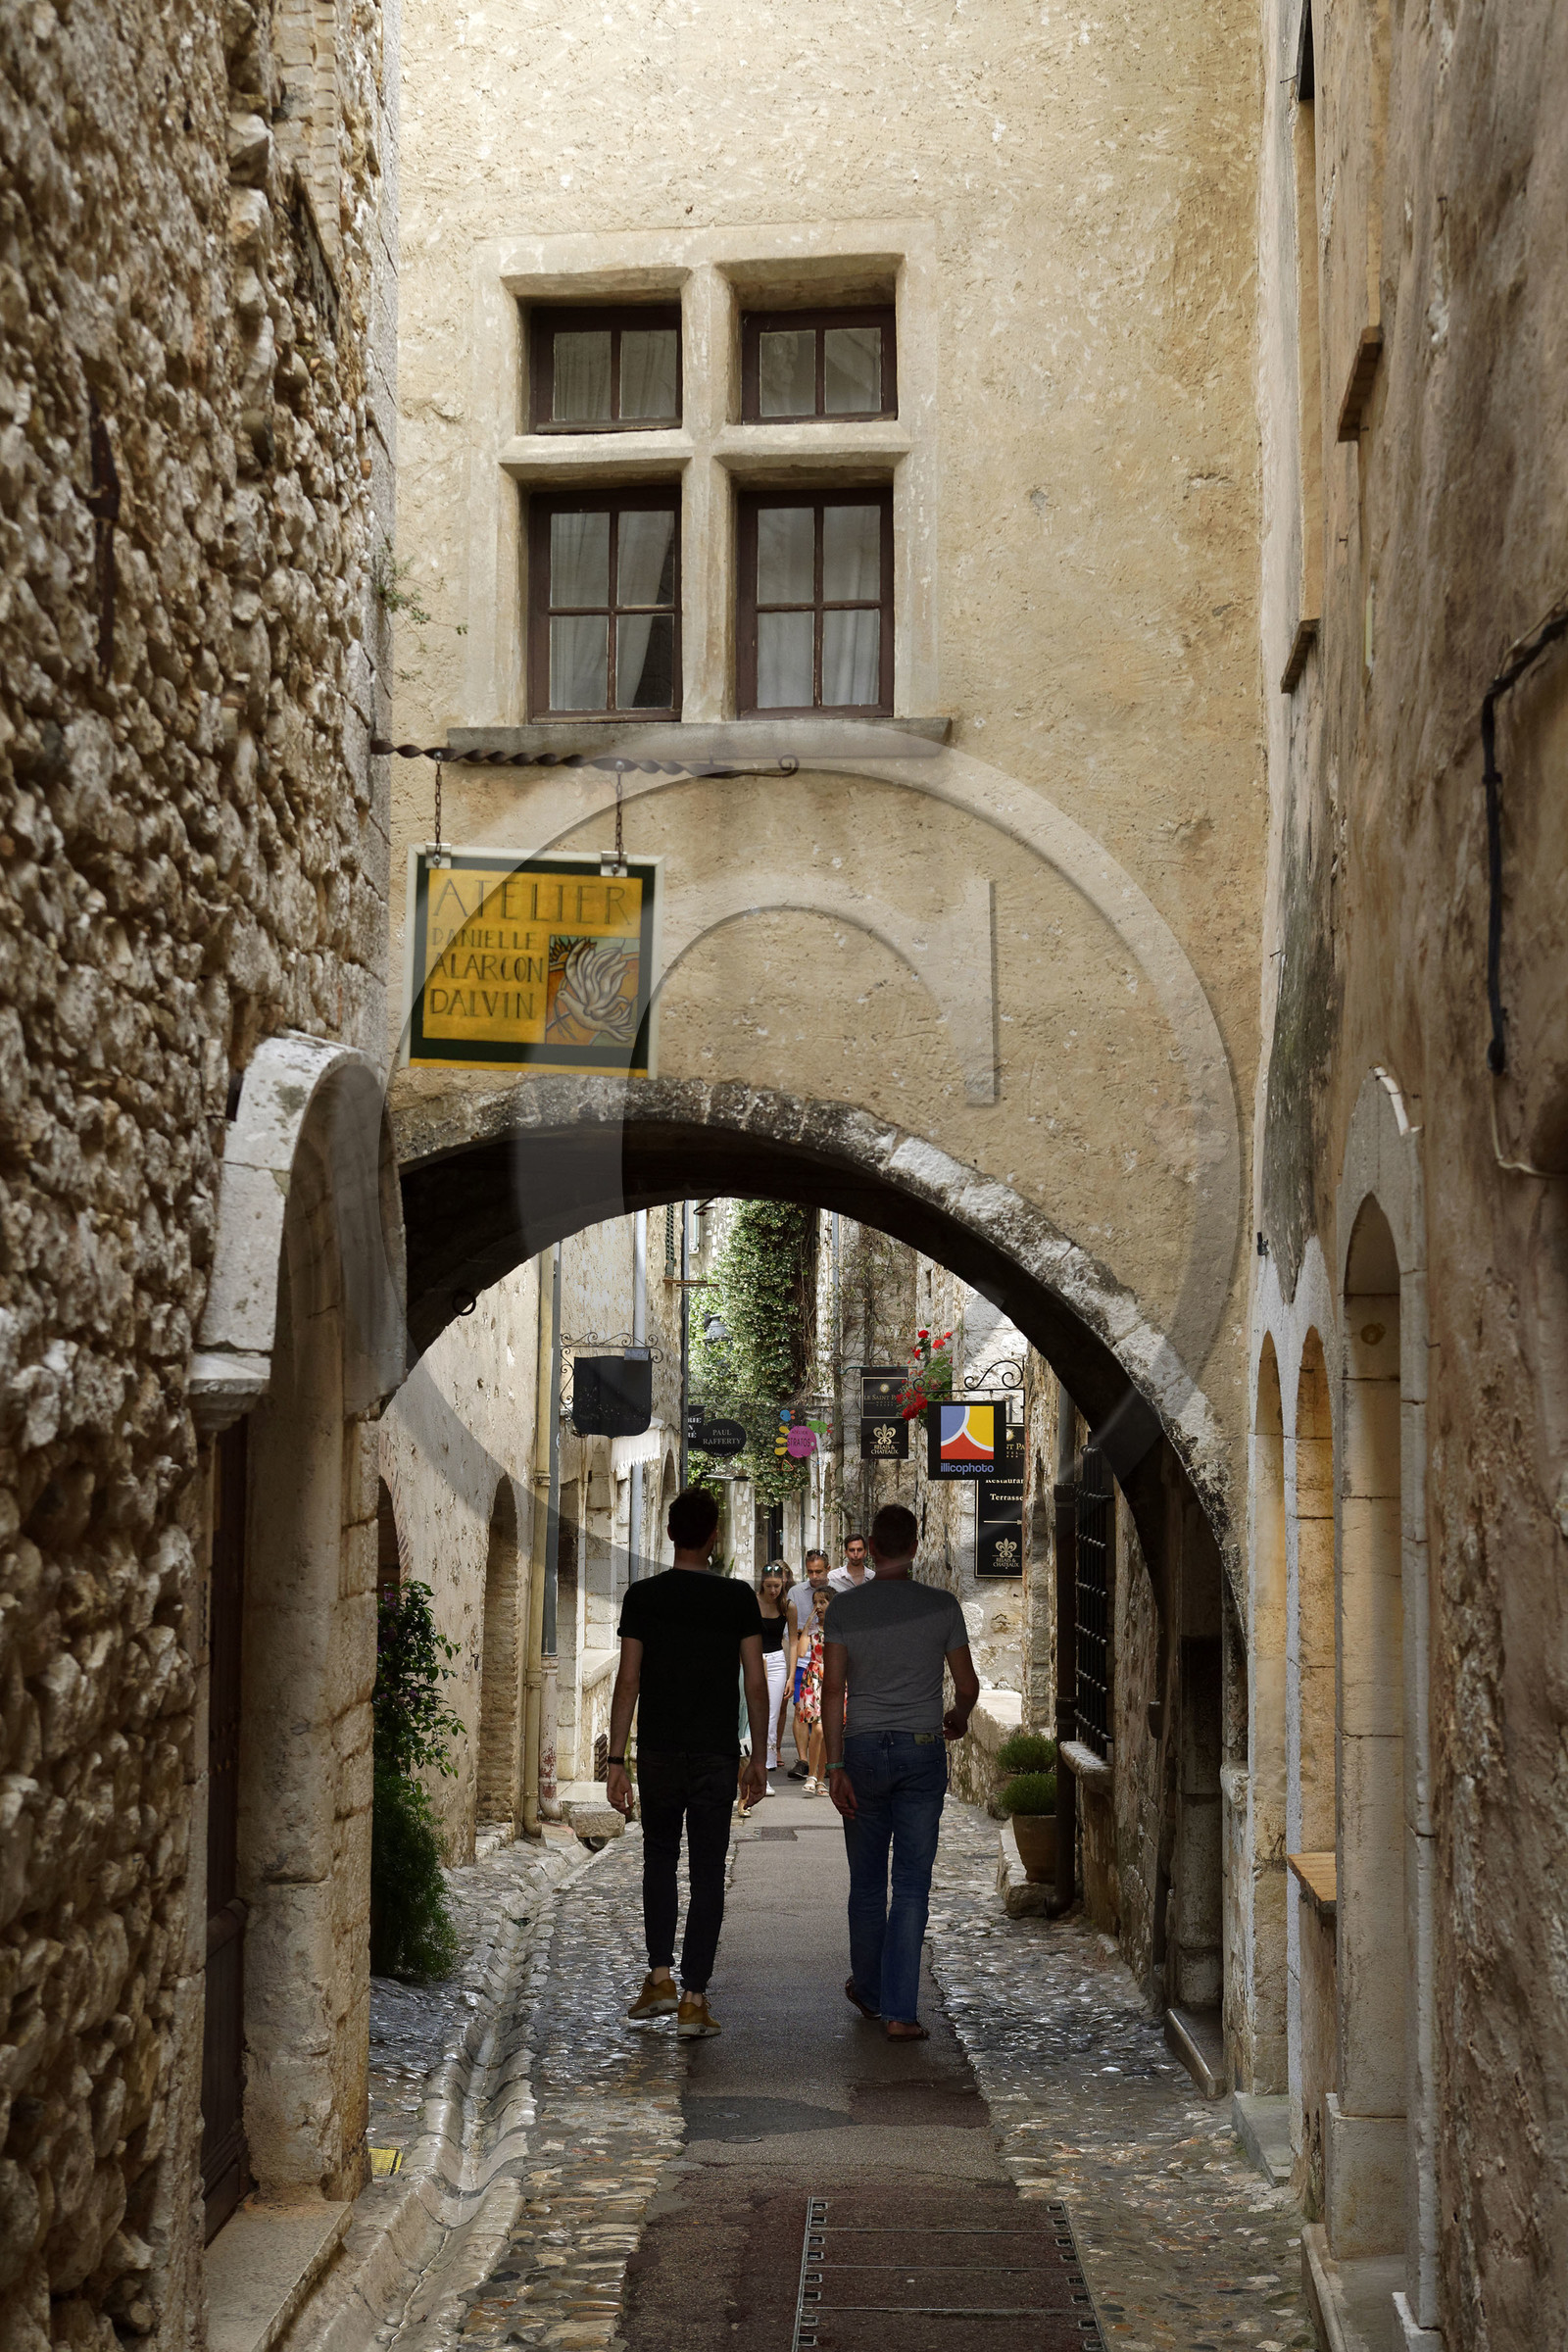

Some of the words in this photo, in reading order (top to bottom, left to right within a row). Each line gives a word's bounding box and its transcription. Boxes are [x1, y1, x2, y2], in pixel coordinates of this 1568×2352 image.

[433, 878, 632, 926] ATELIER
[431, 927, 538, 951] DANIELLE
[430, 953, 544, 983] ALARCON
[430, 988, 534, 1020] DALVIN
[941, 1462, 995, 1476] illicophoto
